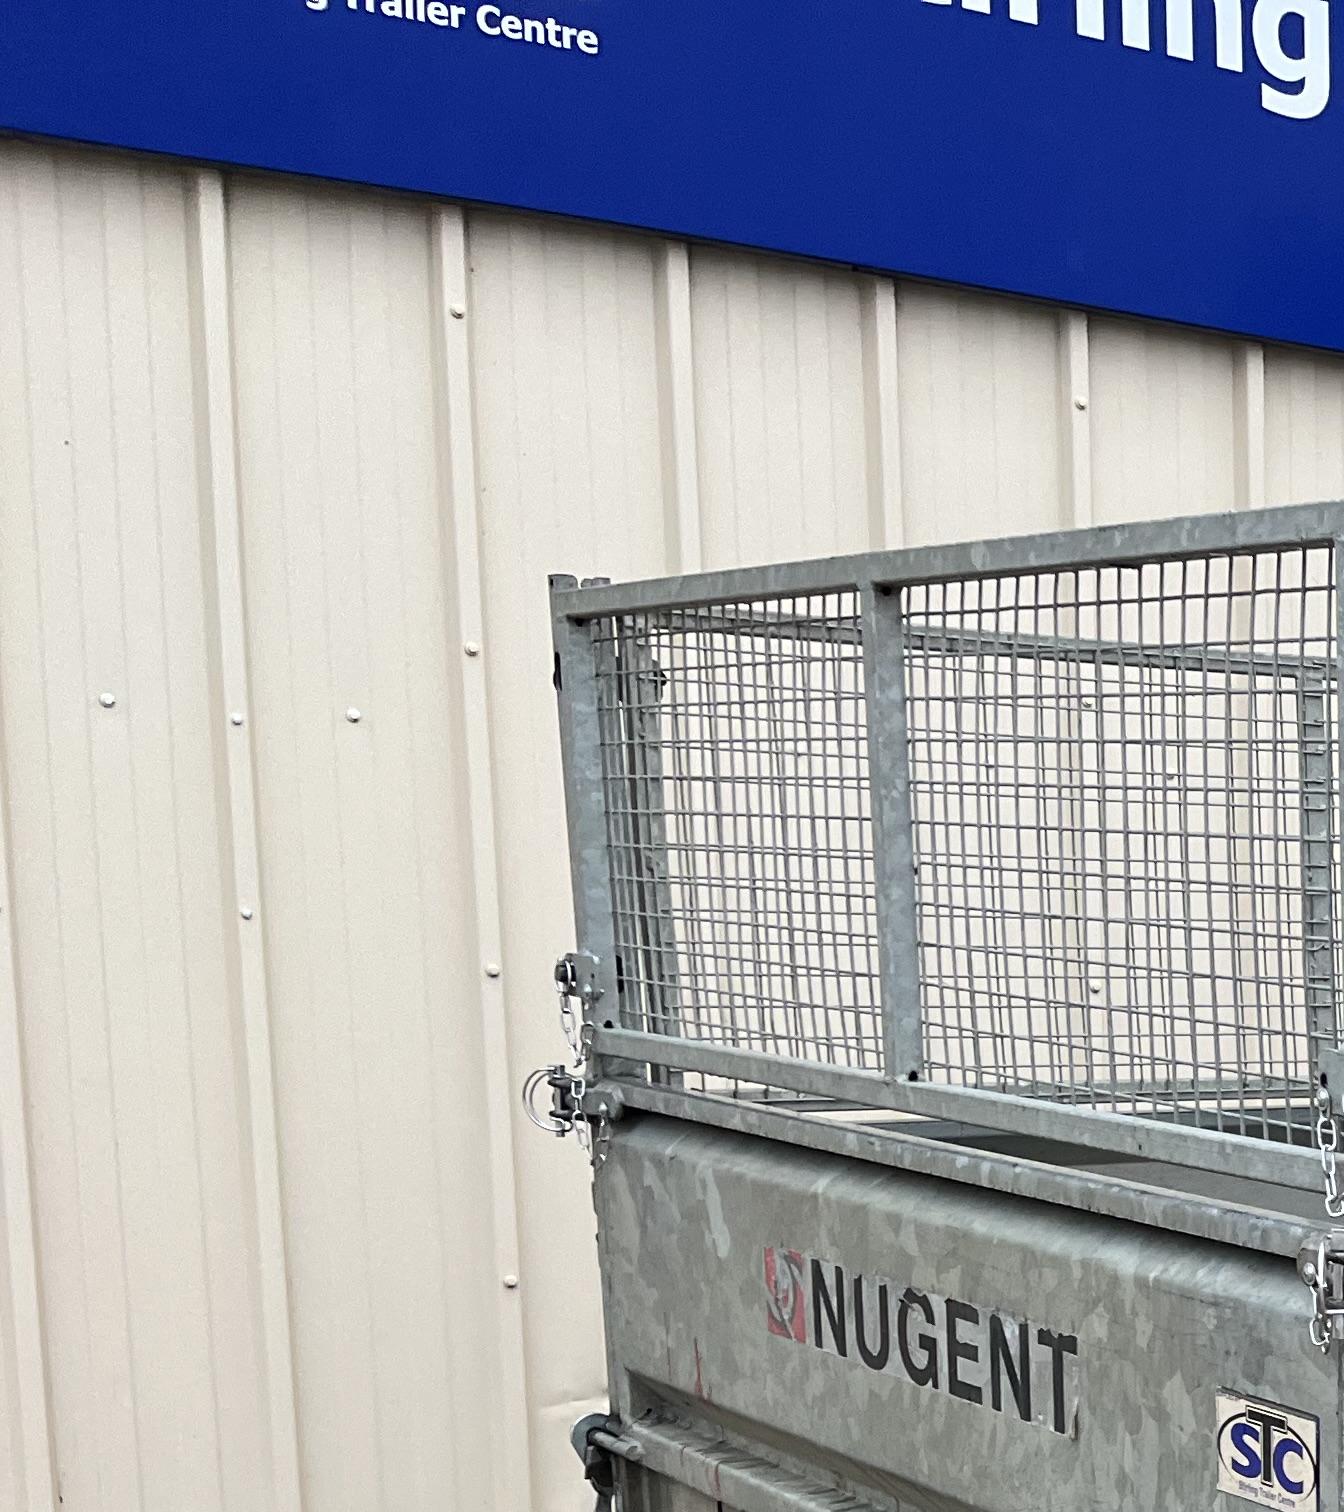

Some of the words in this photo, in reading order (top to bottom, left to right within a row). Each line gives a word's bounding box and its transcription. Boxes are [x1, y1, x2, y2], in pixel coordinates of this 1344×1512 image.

[476, 4, 599, 54] Centre
[811, 1258, 1078, 1434] NUGENT
[1230, 1404, 1304, 1494] STC
